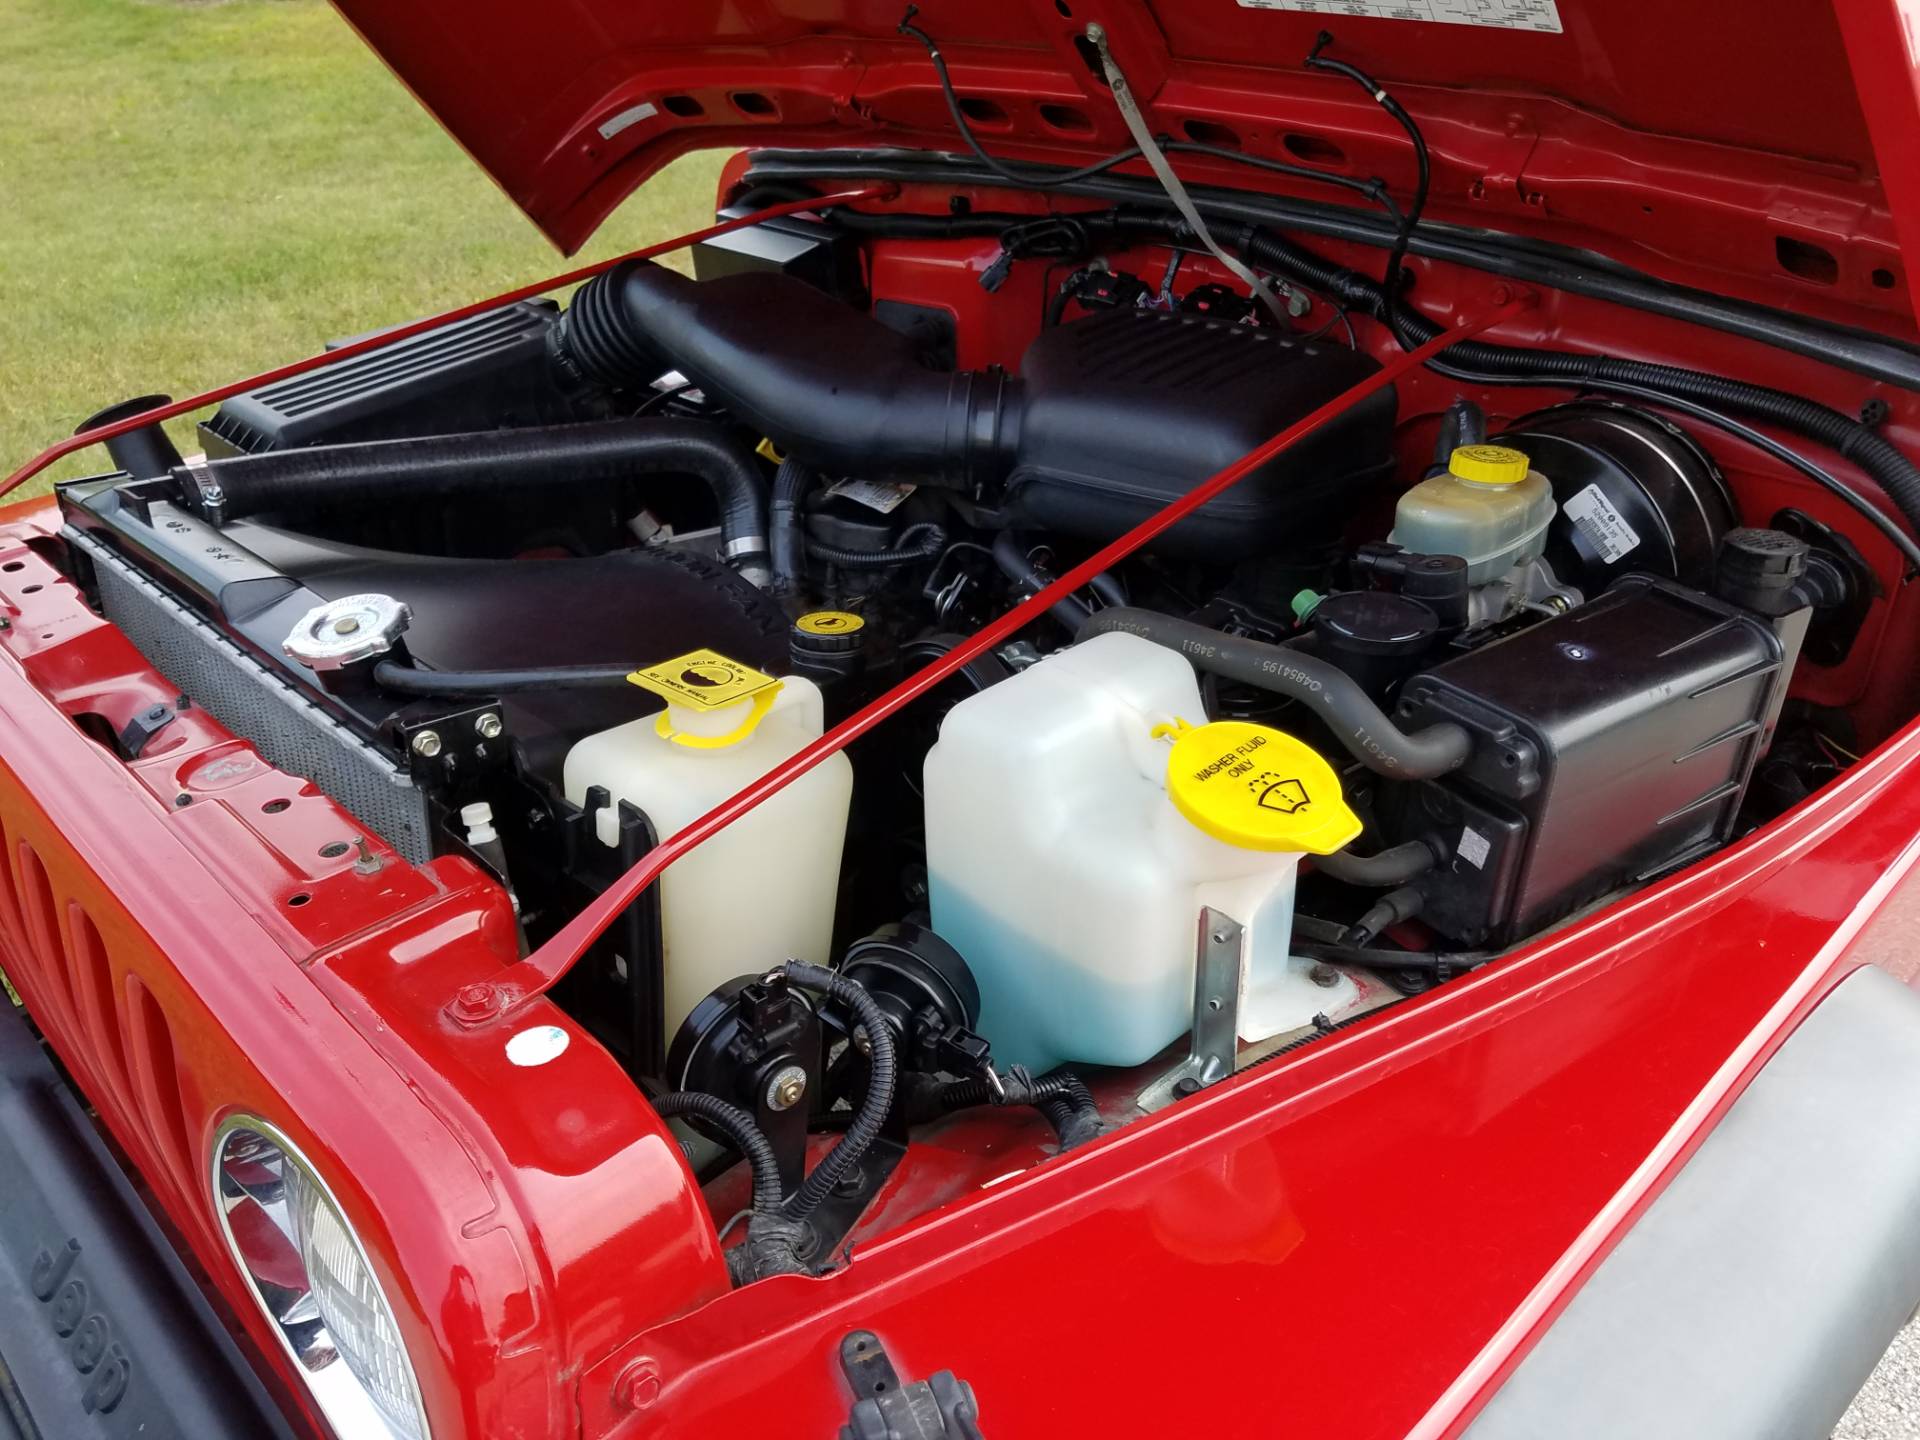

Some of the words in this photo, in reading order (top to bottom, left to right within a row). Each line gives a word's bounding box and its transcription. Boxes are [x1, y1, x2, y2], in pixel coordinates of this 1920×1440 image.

[1194, 752, 1239, 782] WASHER
[1237, 735, 1267, 757] FLUID
[1227, 758, 1256, 779] ONLY
[31, 1237, 131, 1416] Jeep
